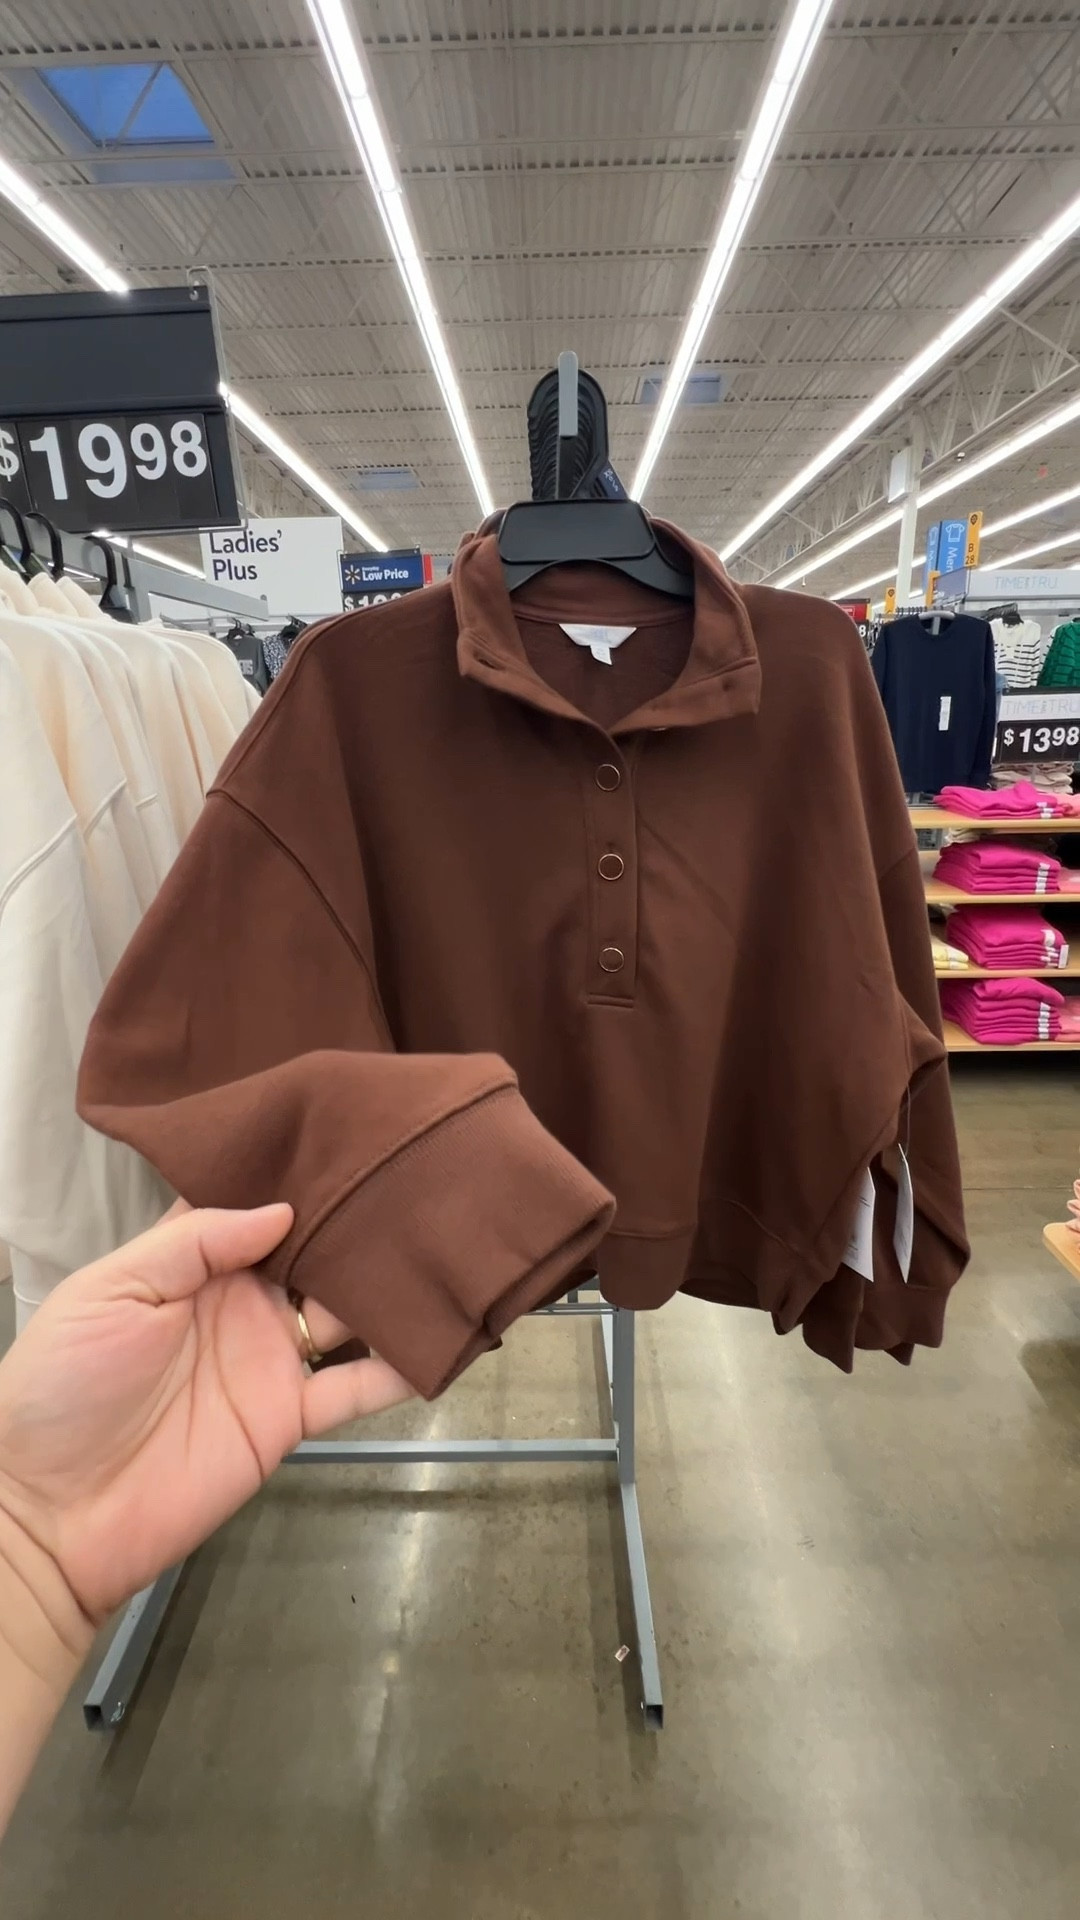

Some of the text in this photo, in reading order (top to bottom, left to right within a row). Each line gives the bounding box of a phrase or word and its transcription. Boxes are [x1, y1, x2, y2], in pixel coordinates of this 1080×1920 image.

[969, 543, 974, 552] B
[965, 554, 975, 565] 28
[212, 558, 258, 581] Plus
[362, 568, 409, 581] Low Price
